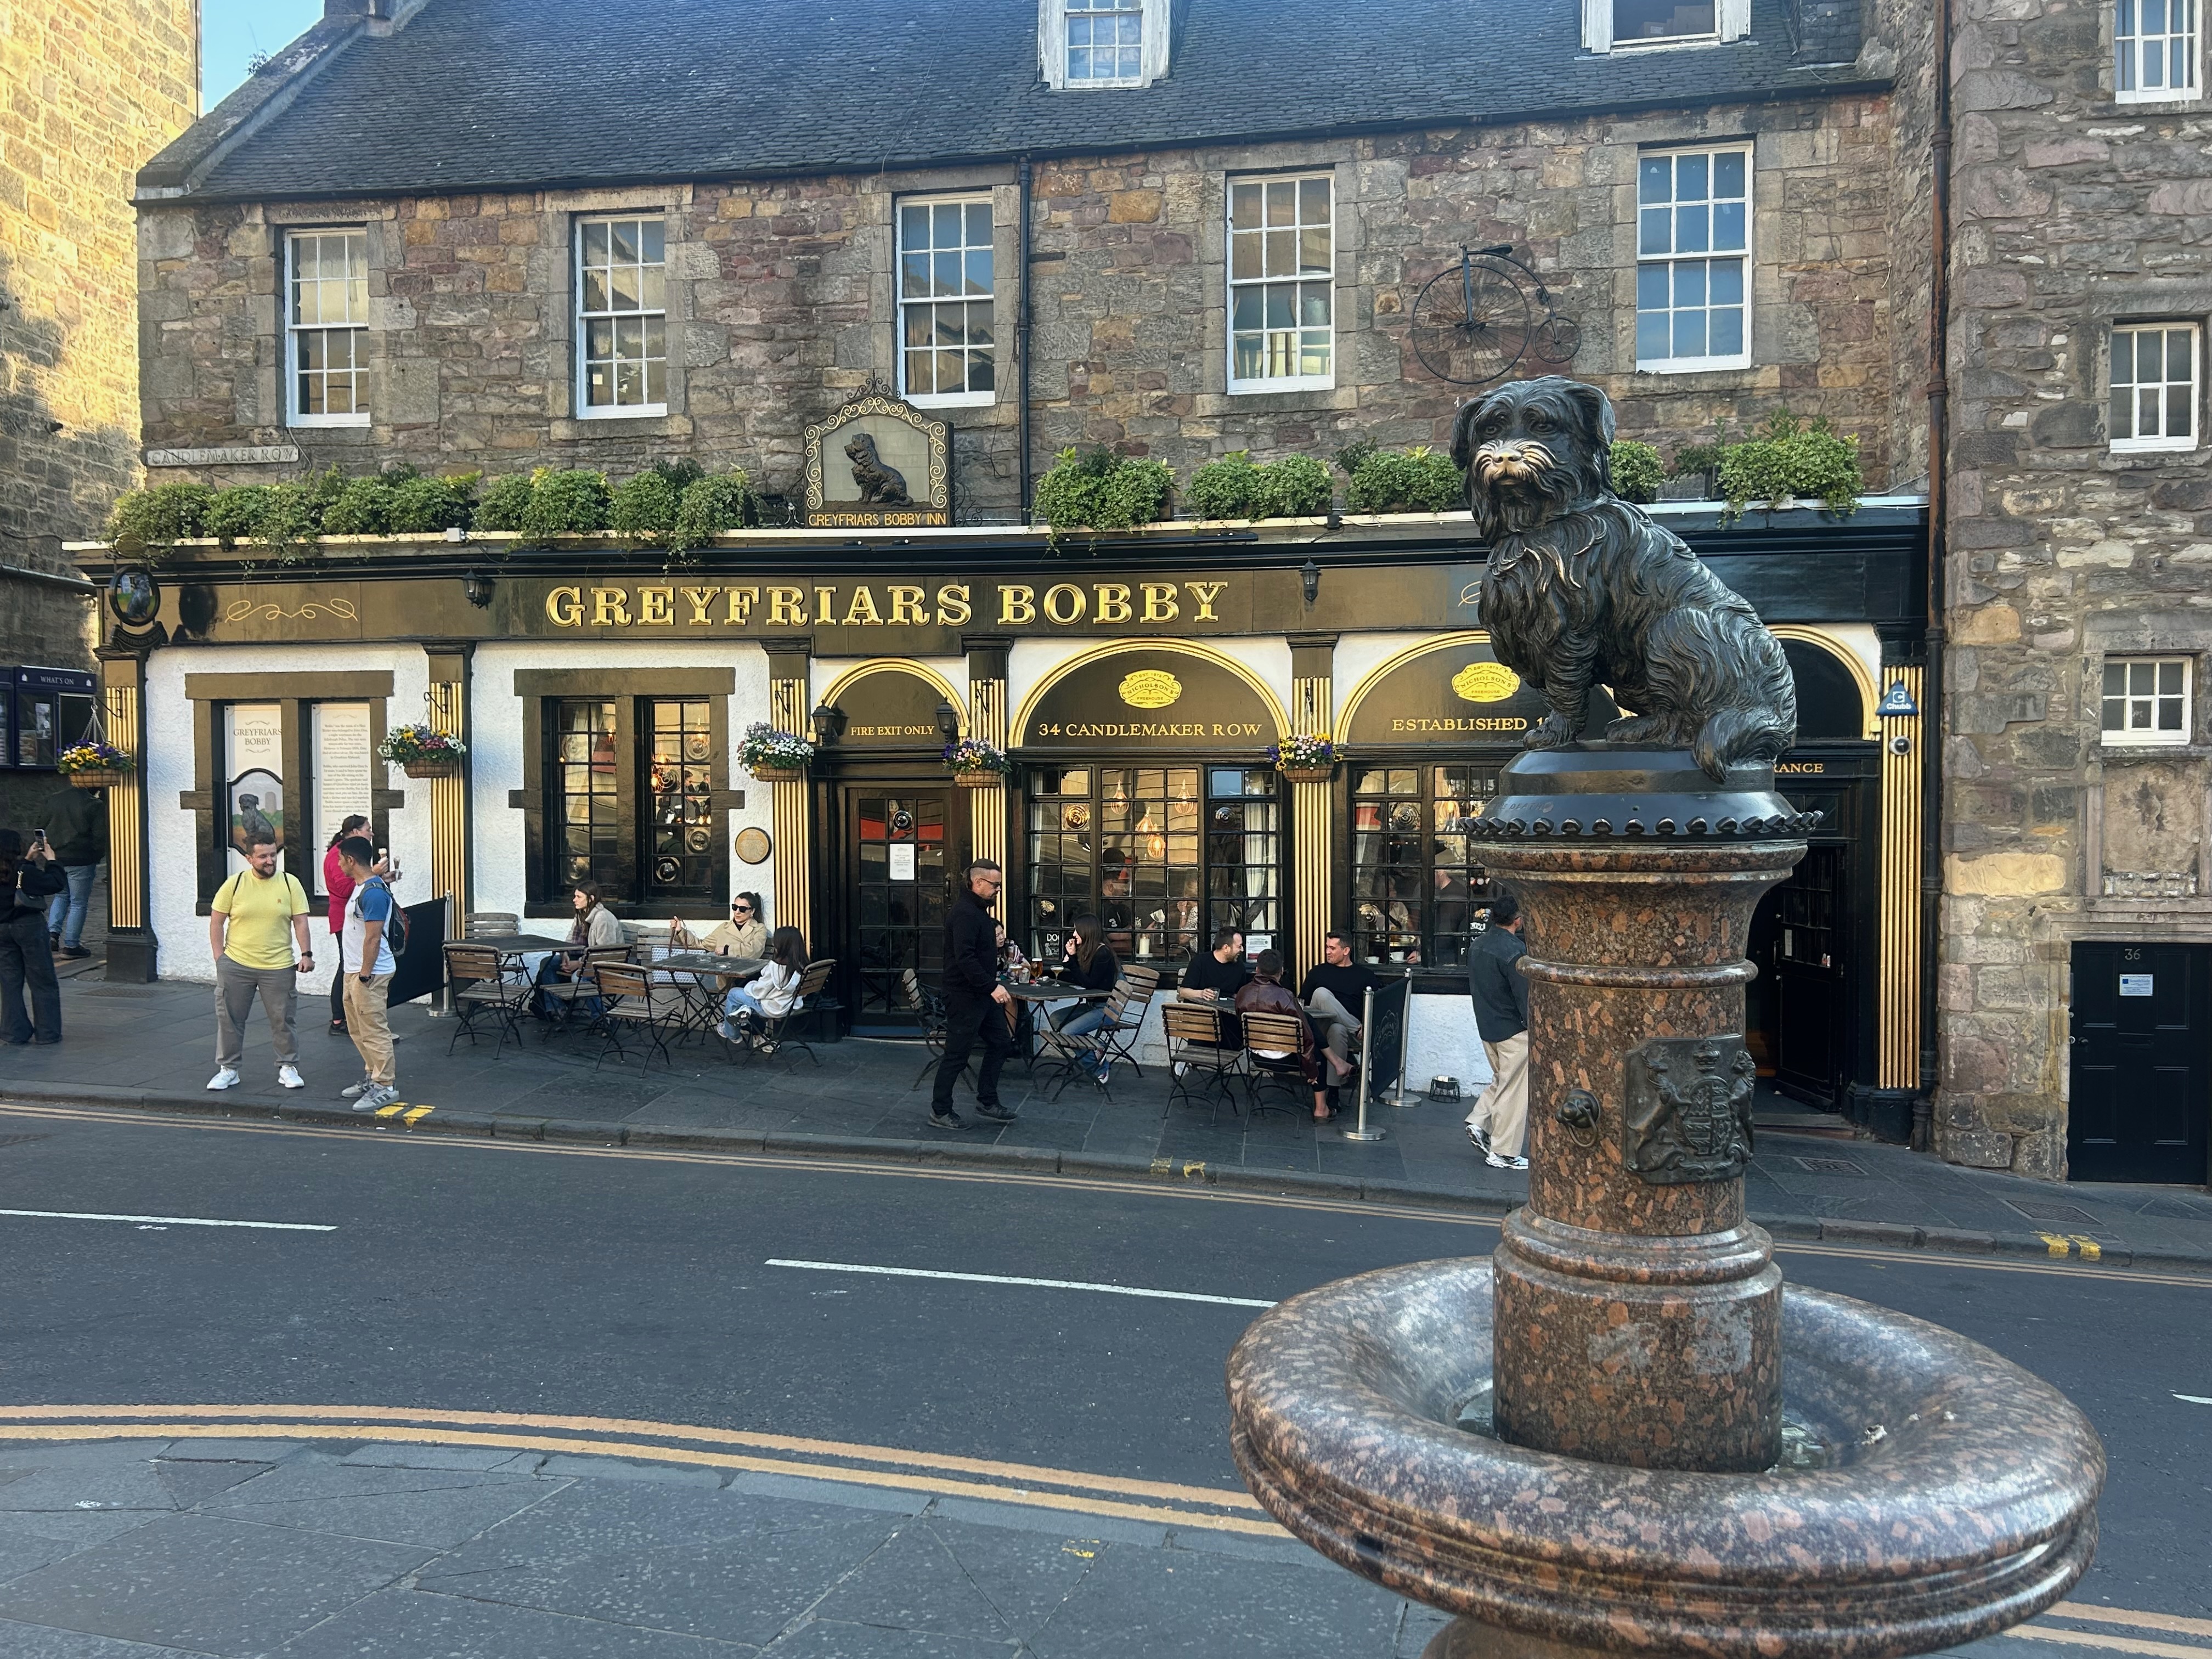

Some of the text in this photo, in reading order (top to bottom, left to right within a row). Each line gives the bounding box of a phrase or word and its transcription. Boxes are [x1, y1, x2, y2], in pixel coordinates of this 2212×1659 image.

[152, 448, 294, 465] CANDLEMAKER ROW
[808, 512, 946, 526] GREYFRIARS BOBBY INN
[545, 582, 1228, 627] GREYFRIARS BOBBY
[40, 675, 63, 684] WHAT'S
[850, 725, 935, 736] FIRE EXIT ONLY
[1039, 723, 1262, 736] 34 CANDLEMAKER ROW
[1391, 718, 1527, 731] ESTABLISHED
[245, 737, 272, 746] BOBBY
[2124, 949, 2141, 960] 36
